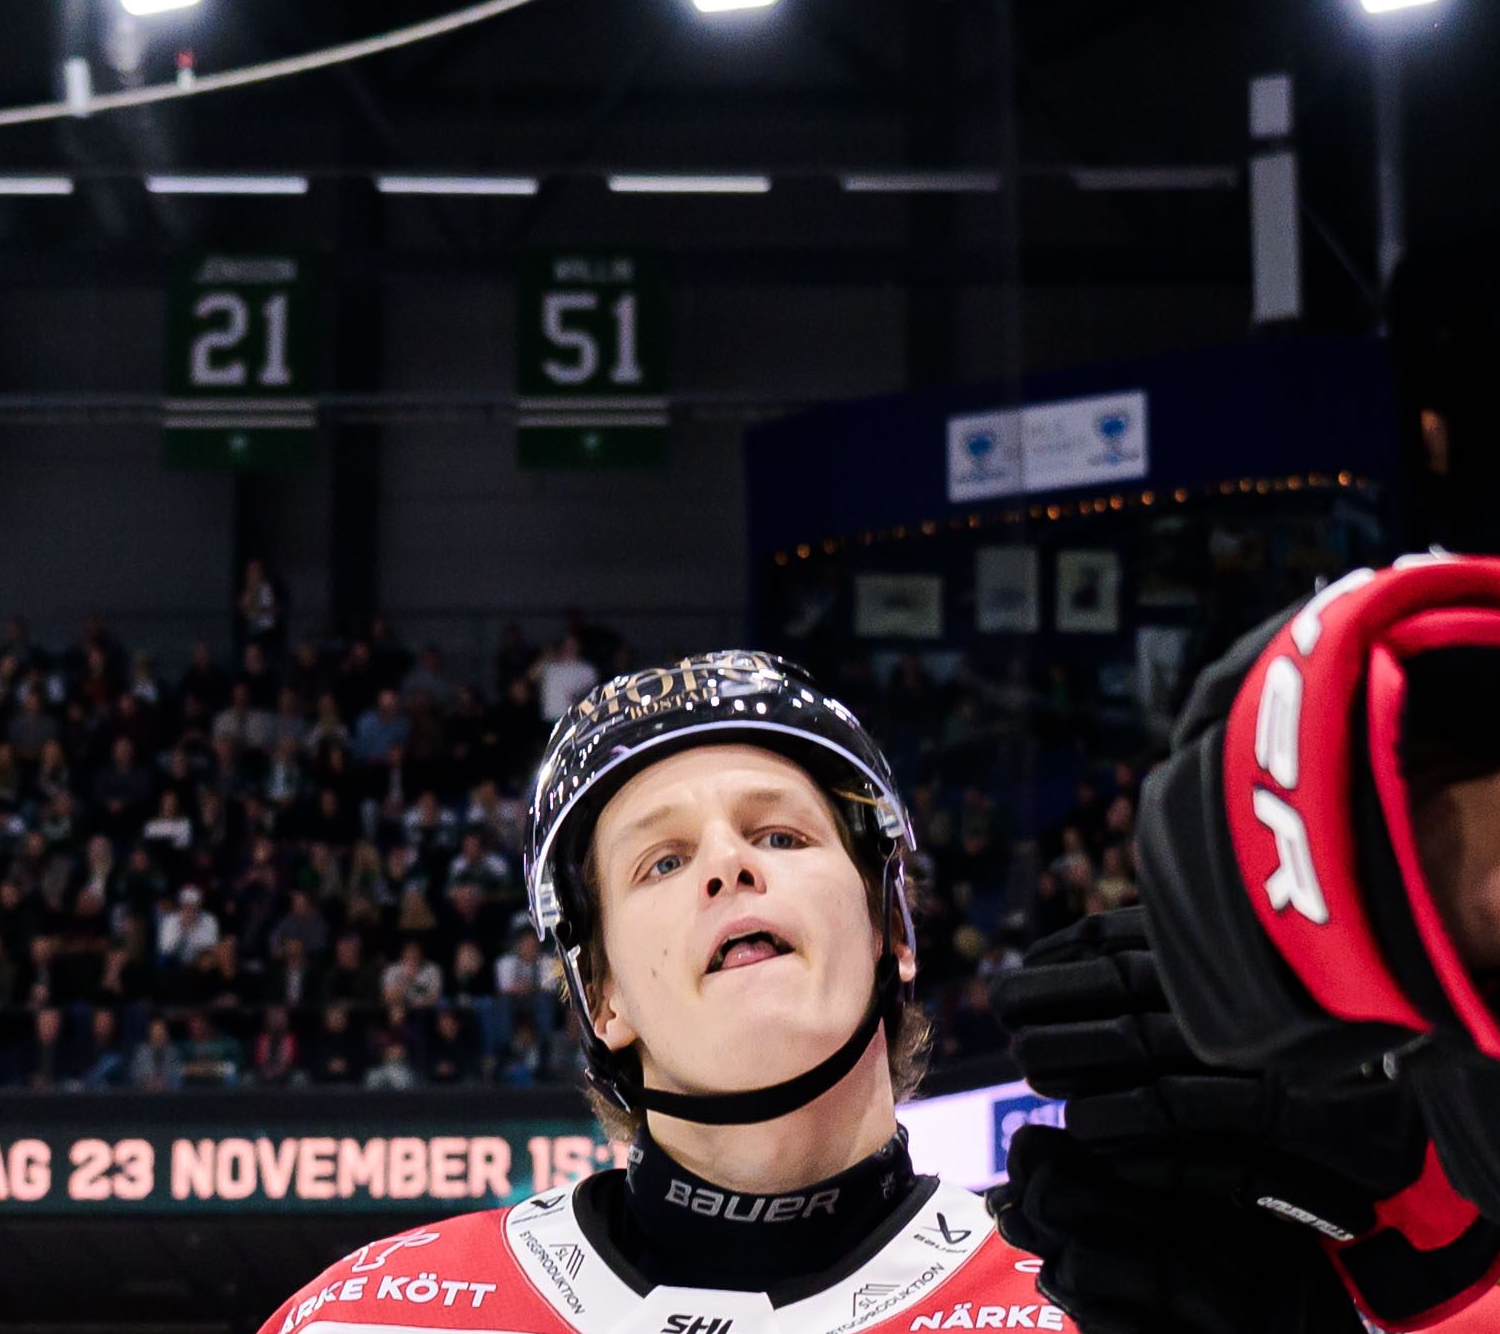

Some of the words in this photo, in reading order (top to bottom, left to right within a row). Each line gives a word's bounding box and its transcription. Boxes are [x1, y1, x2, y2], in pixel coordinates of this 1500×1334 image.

[188, 291, 294, 387] 21
[539, 291, 644, 386] 51
[68, 1139, 155, 1202] 23
[171, 1135, 510, 1202] NOVEMBER
[664, 1177, 841, 1223] BAUER
[376, 1271, 498, 1308] KÖTT
[908, 1301, 1066, 1333] NÄRKE
